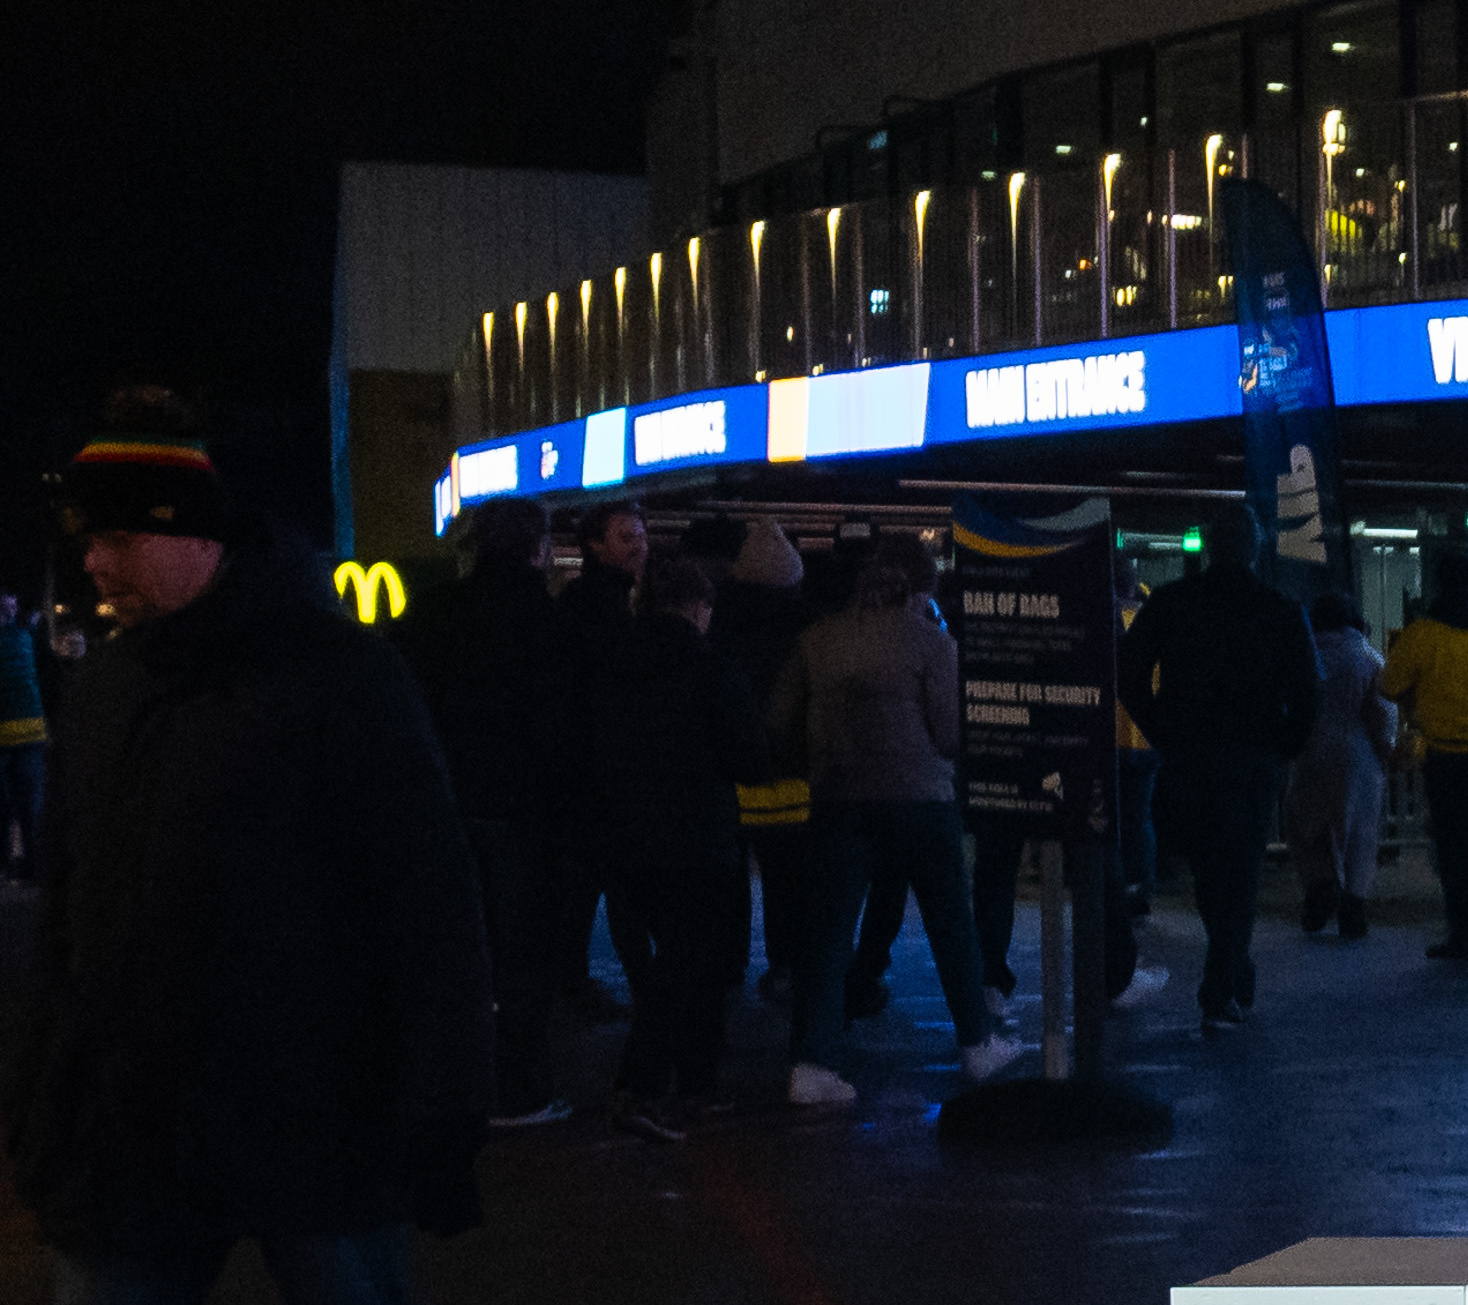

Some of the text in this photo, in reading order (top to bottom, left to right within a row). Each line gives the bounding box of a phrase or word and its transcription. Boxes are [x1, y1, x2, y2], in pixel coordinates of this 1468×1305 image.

[966, 350, 1146, 429] MAIN ENTRANCE
[963, 590, 1060, 619] BAN OF BAGS
